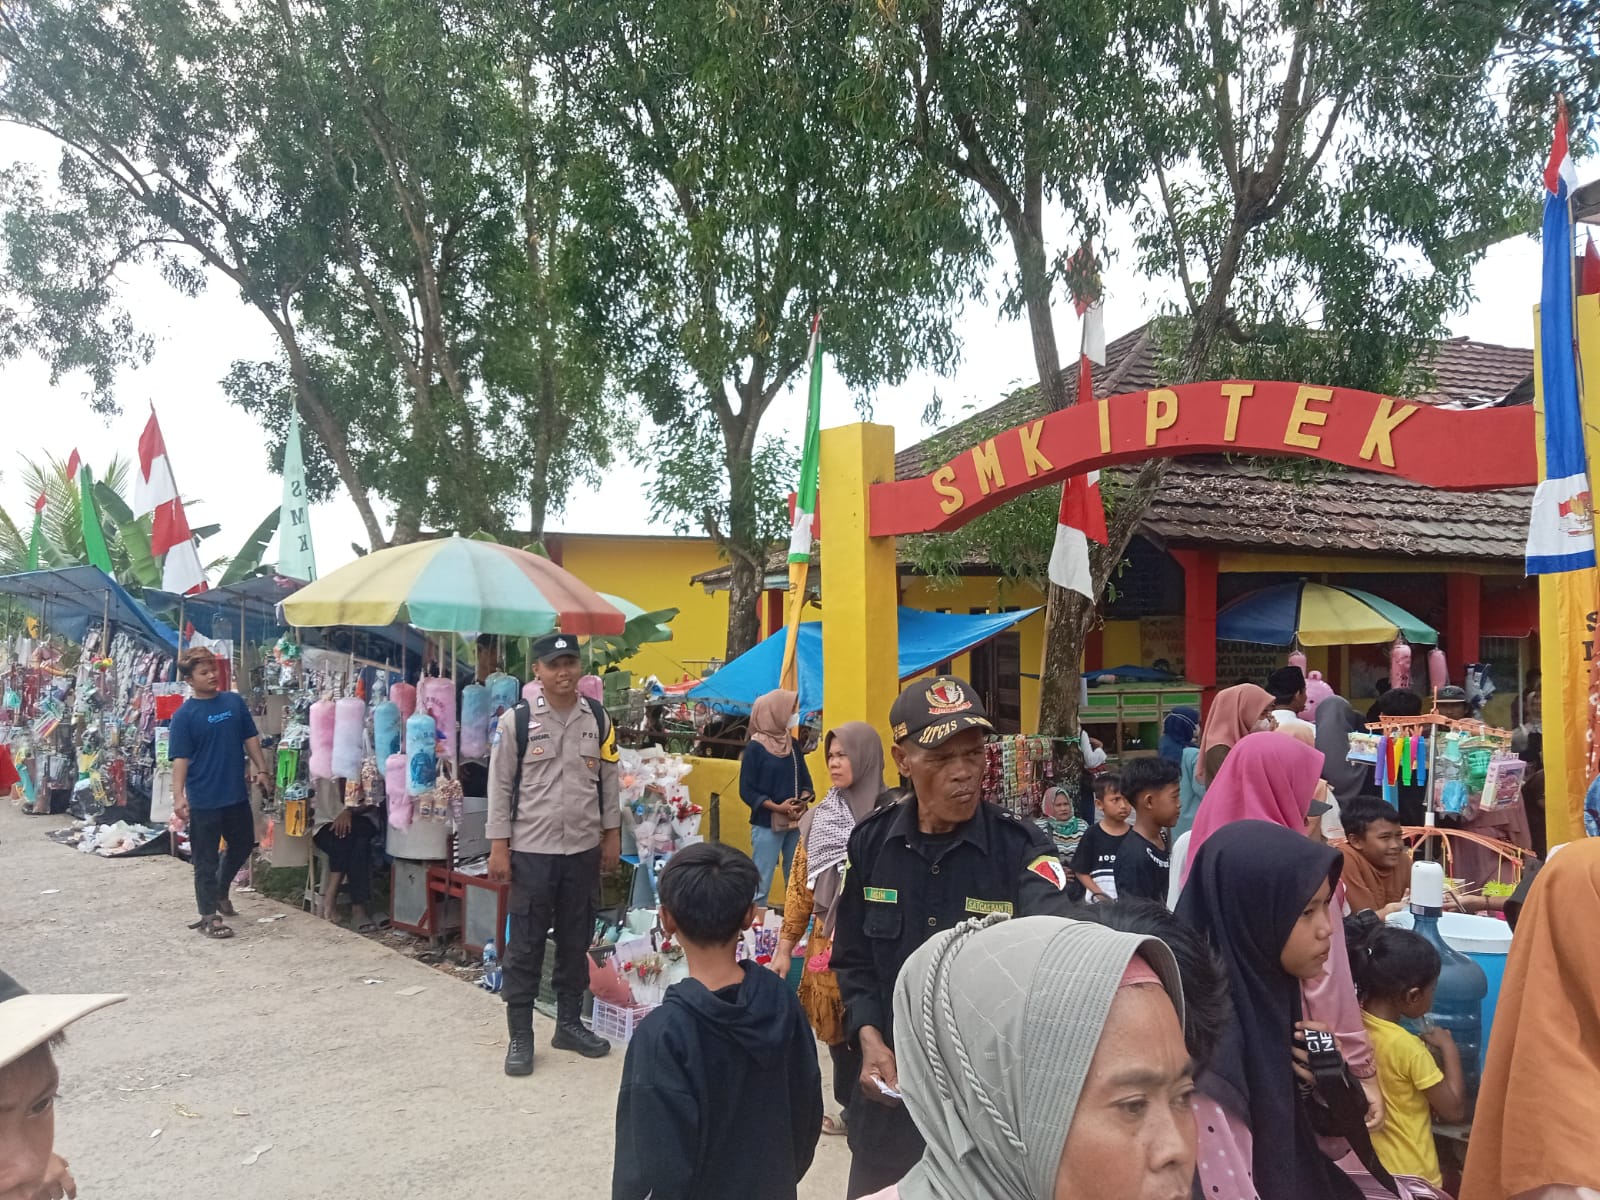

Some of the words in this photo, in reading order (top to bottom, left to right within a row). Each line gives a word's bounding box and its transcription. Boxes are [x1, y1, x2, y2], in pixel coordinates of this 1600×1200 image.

[932, 418, 1054, 515] SMK
[1097, 383, 1420, 468] IPTEK
[1233, 655, 1277, 665] TANGAN
[582, 732, 597, 740] POL
